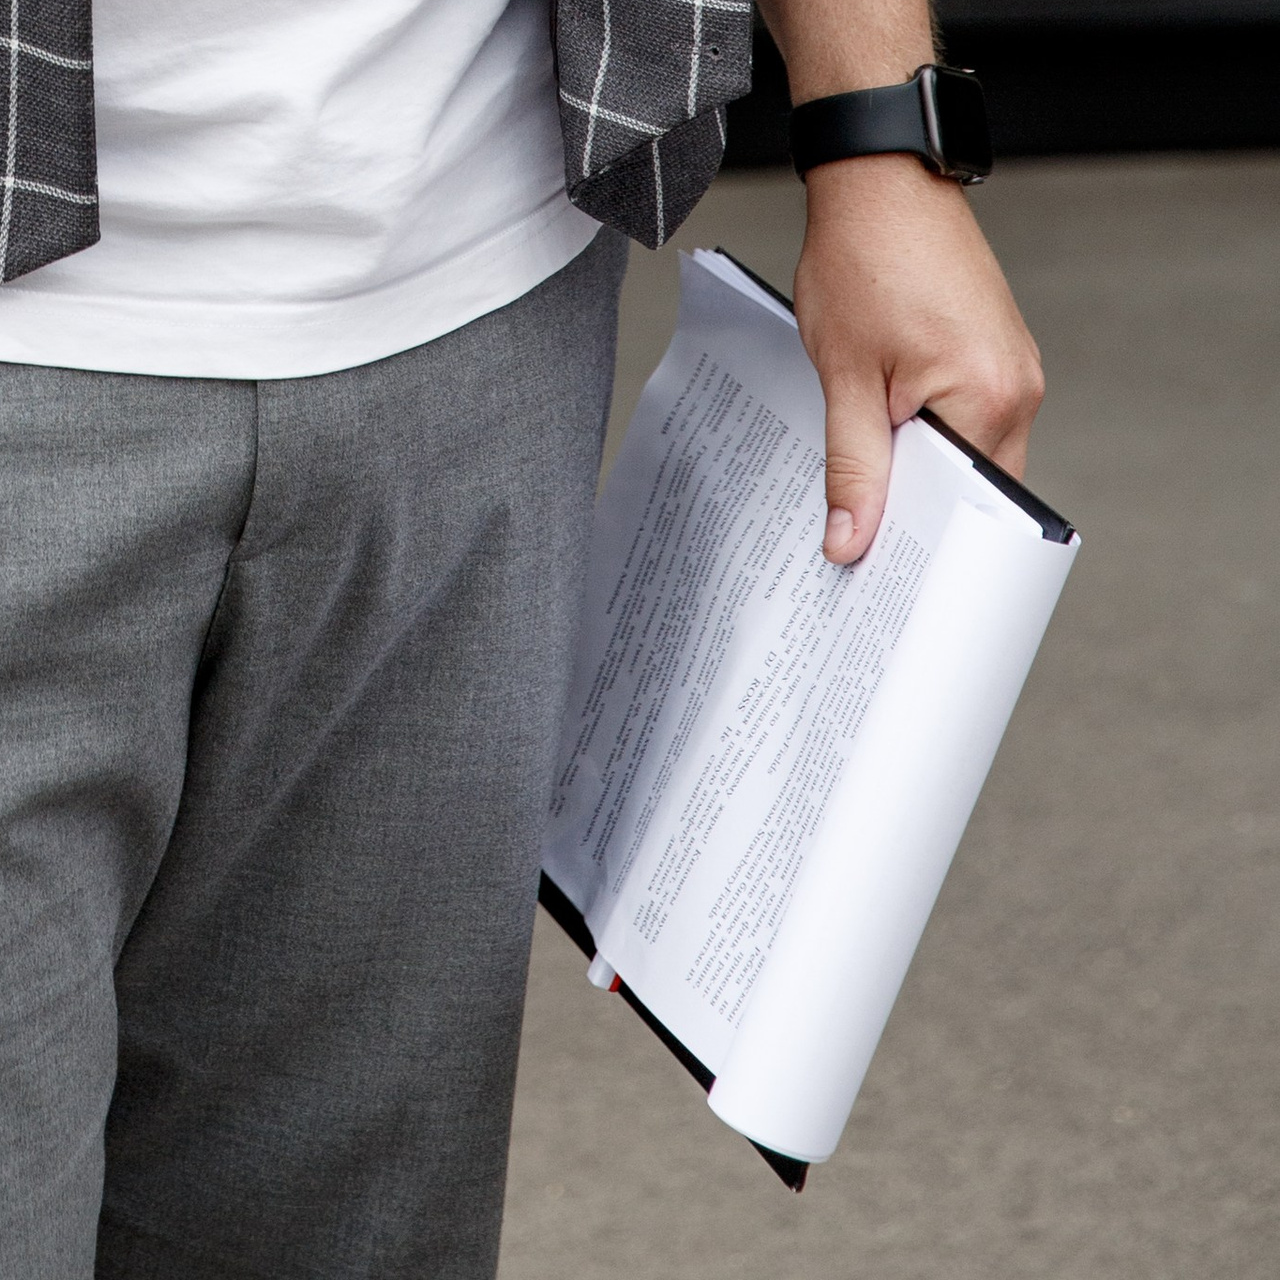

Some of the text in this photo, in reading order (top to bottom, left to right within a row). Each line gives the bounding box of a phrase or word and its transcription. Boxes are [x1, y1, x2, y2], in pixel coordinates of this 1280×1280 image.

[763, 552, 794, 601] DJROSS
[892, 534, 912, 573] новый
[812, 587, 824, 607] все
[827, 568, 854, 618] Сегодня
[877, 574, 902, 622] Именно
[879, 546, 924, 636] выразительные
[888, 551, 930, 635] ограничивают
[779, 590, 811, 640] музыкой
[798, 612, 811, 631] это
[836, 604, 871, 672] Встречайте
[781, 621, 817, 682] досуговых
[783, 633, 798, 655] для
[808, 636, 820, 657] нас
[815, 605, 854, 681] выступление
[845, 632, 865, 671] новую
[852, 624, 878, 671] поэтому
[853, 637, 880, 690] средства
[870, 647, 885, 675] себя
[741, 658, 784, 726] погружения
[780, 673, 801, 707] парке
[810, 673, 838, 728] бурными
[832, 675, 853, 718] группе
[837, 693, 854, 725] таких
[840, 685, 866, 738] рамками
[848, 666, 884, 739] популярных
[766, 682, 817, 775] StrawberryFields
[818, 728, 838, 770] стилей
[707, 740, 734, 786] полную
[719, 746, 744, 786] мастер
[725, 730, 768, 797] настоящему
[762, 729, 812, 827] аплодисментами
[795, 728, 821, 783] заставить
[817, 750, 838, 793] одного
[789, 767, 813, 816] придать
[807, 756, 844, 837] музыкальных
[809, 772, 820, 791] как
[700, 802, 724, 844] жарко!
[774, 785, 796, 827] сердце
[744, 829, 775, 880] зрителей
[767, 818, 791, 863] каждой
[779, 804, 815, 880] направления
[720, 881, 747, 920] биться
[747, 865, 767, 898] песне
[726, 900, 747, 934] новое
[693, 929, 716, 967] ритме
[735, 946, 761, 986] Ребята
[709, 950, 744, 1007] применяя
[726, 954, 766, 1022] авторскими
